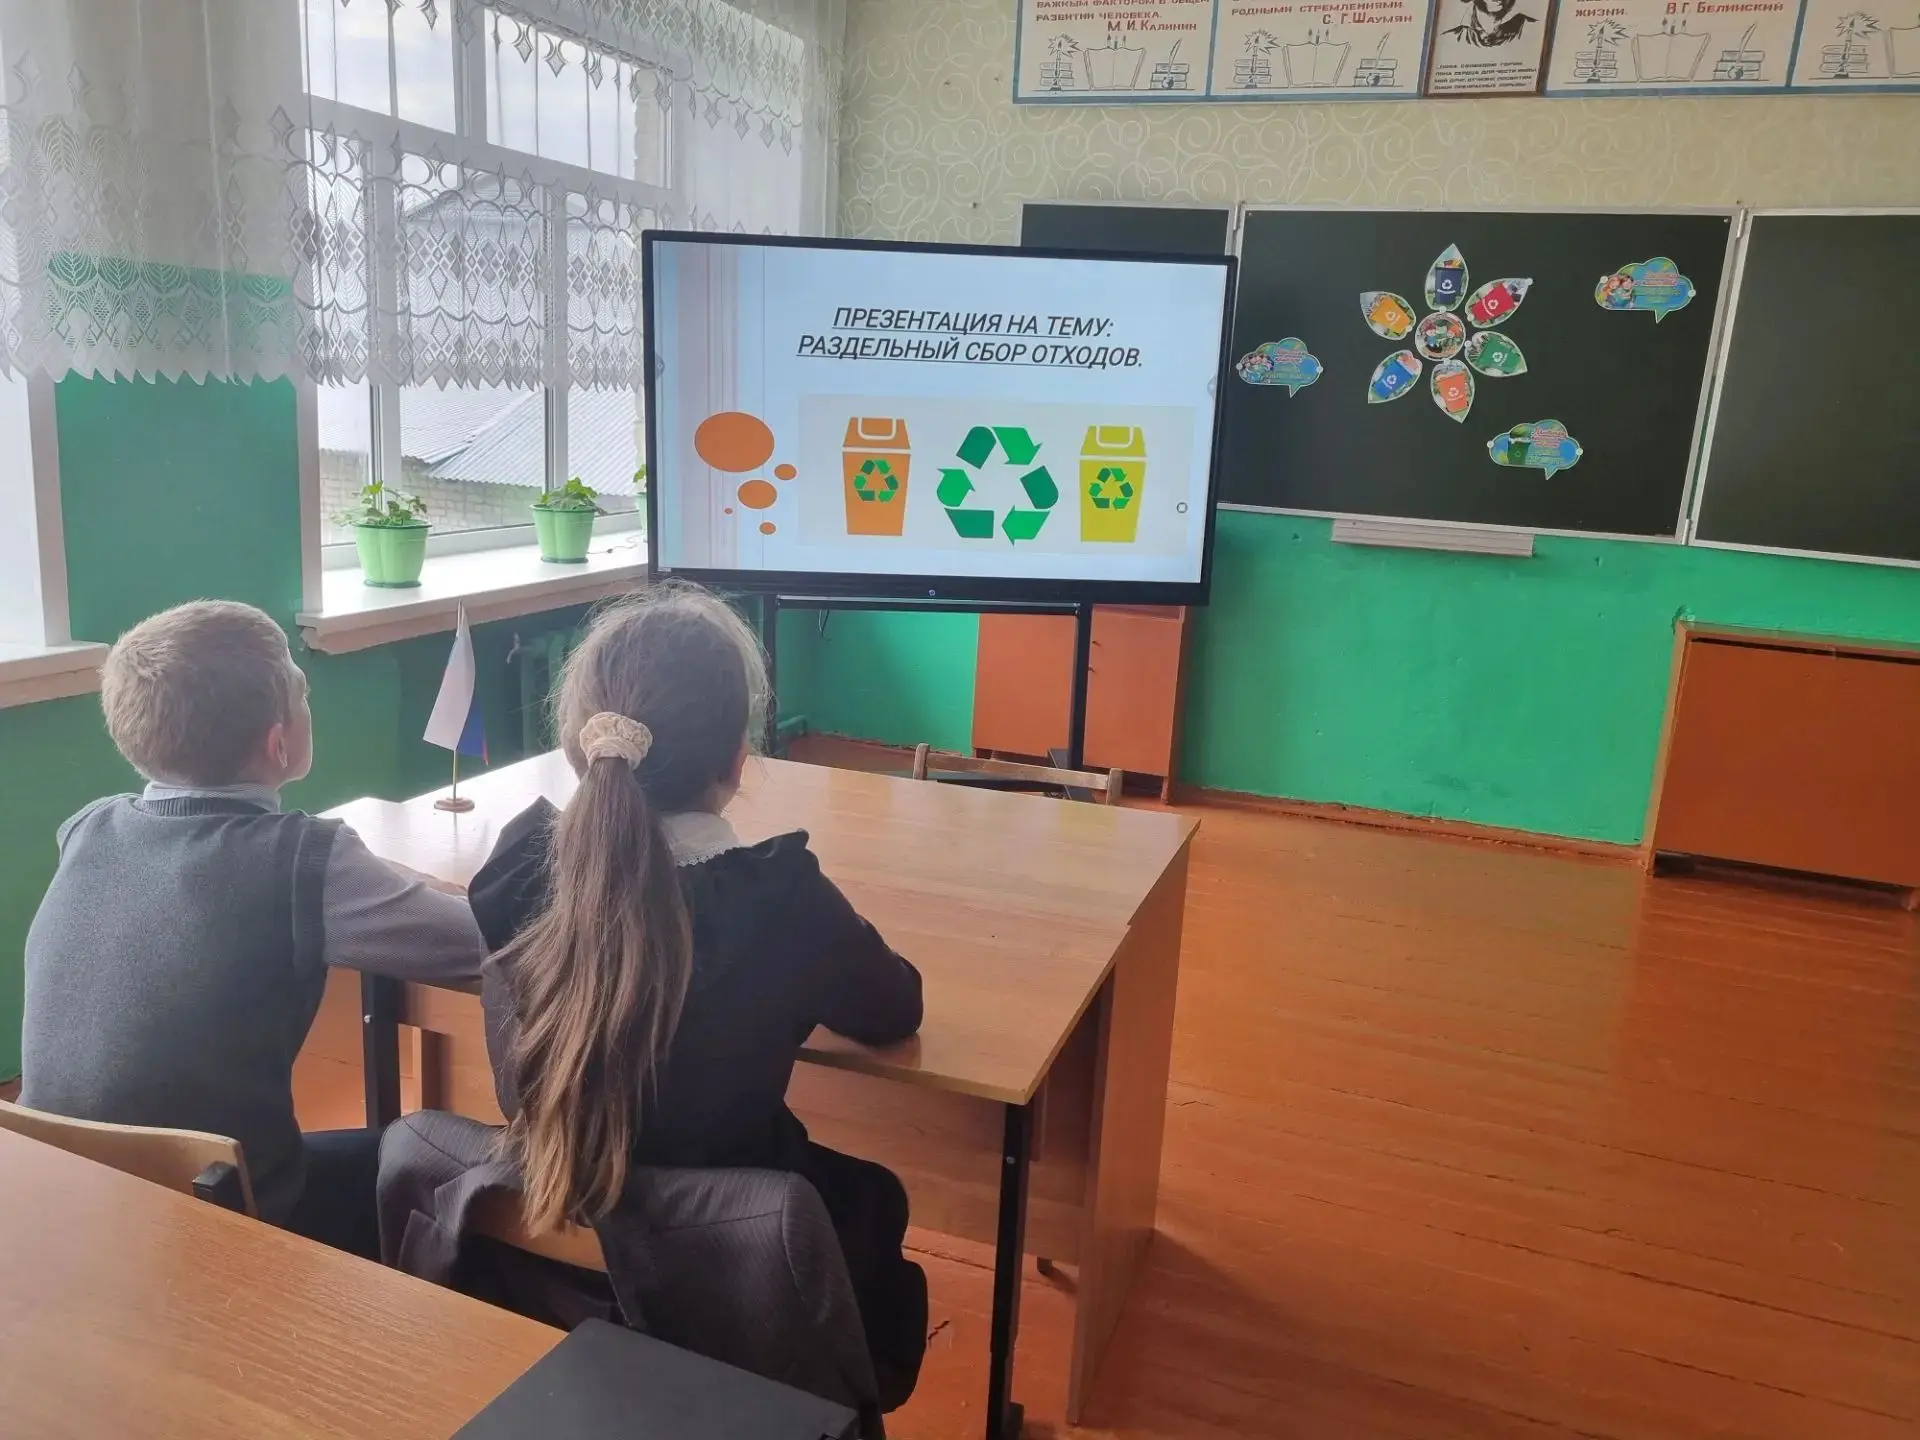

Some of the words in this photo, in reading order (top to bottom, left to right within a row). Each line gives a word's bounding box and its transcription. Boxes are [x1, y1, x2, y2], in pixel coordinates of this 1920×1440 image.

[1036, 0, 1089, 8] ВАЖНЫМ
[1231, 6, 1293, 16] РОДНЫМИ
[1036, 13, 1095, 22] РАЗВИТИИ
[832, 306, 1002, 336] ПРЕЗЕНТАЦИЯ
[1005, 314, 1039, 335] НА
[1046, 316, 1115, 338] ТЕМУ:
[797, 335, 960, 361] РАЗДЕЛЬНЫЙ
[964, 341, 1027, 364] СБОР
[1030, 344, 1143, 370] ОТХОДОВ.
